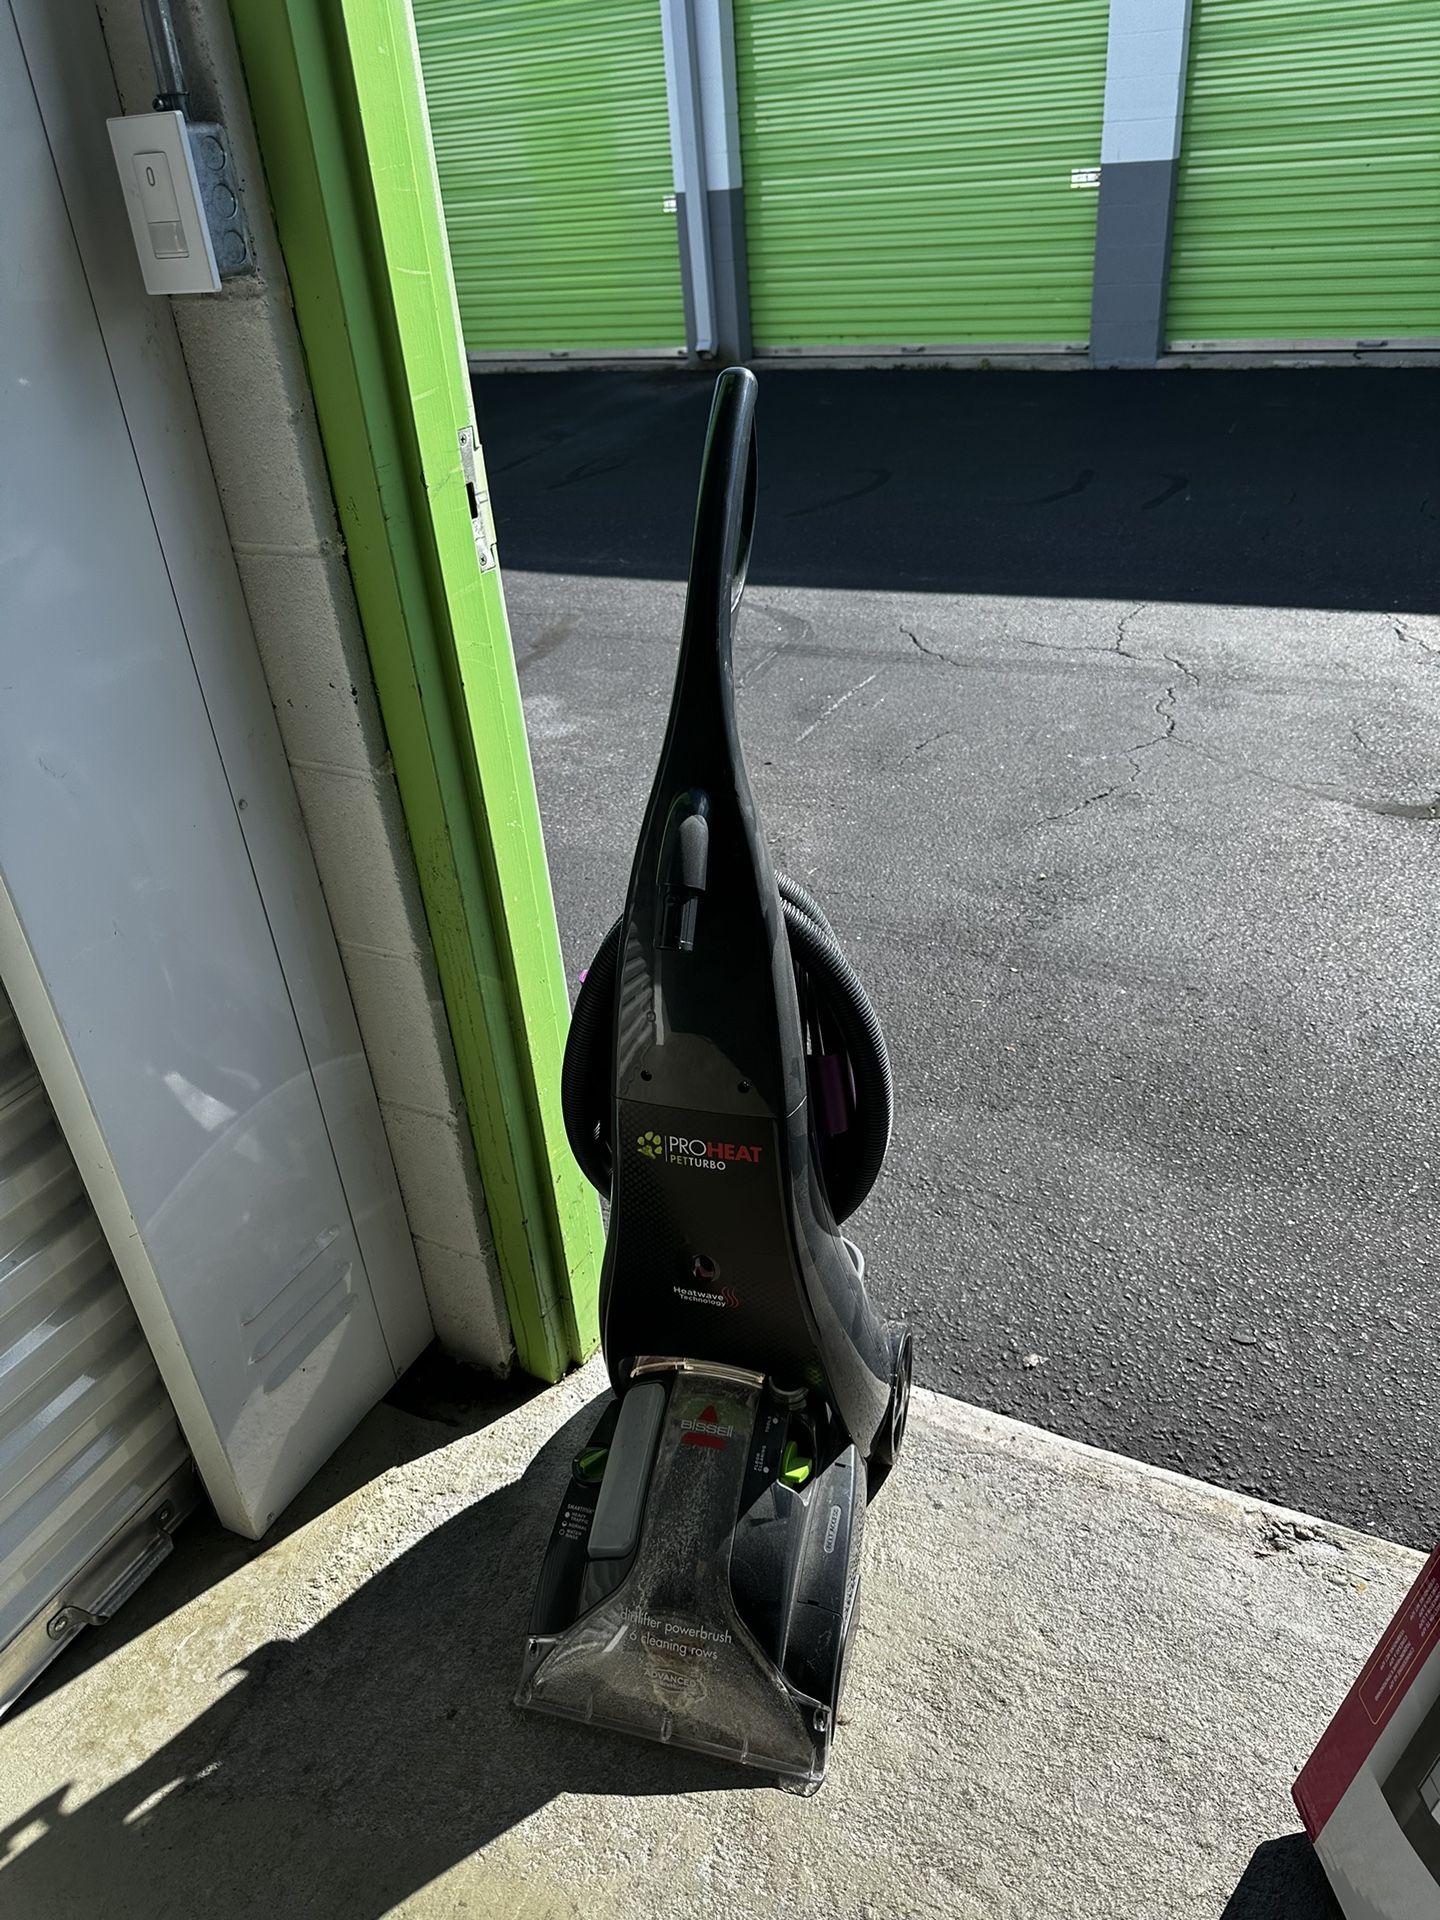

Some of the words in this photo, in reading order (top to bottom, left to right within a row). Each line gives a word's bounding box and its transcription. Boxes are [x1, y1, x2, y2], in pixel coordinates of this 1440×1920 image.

[669, 1136, 762, 1162] PROHEAT
[670, 1154, 726, 1170] PETTURBO
[673, 1285, 724, 1301] Heatwave
[680, 1293, 726, 1308] Technology
[664, 1625, 732, 1644] powerbrush
[629, 1631, 638, 1641] 6
[640, 1632, 687, 1657] cleaning
[691, 1647, 718, 1661] rows
[643, 1667, 697, 1688] ADVANCED
